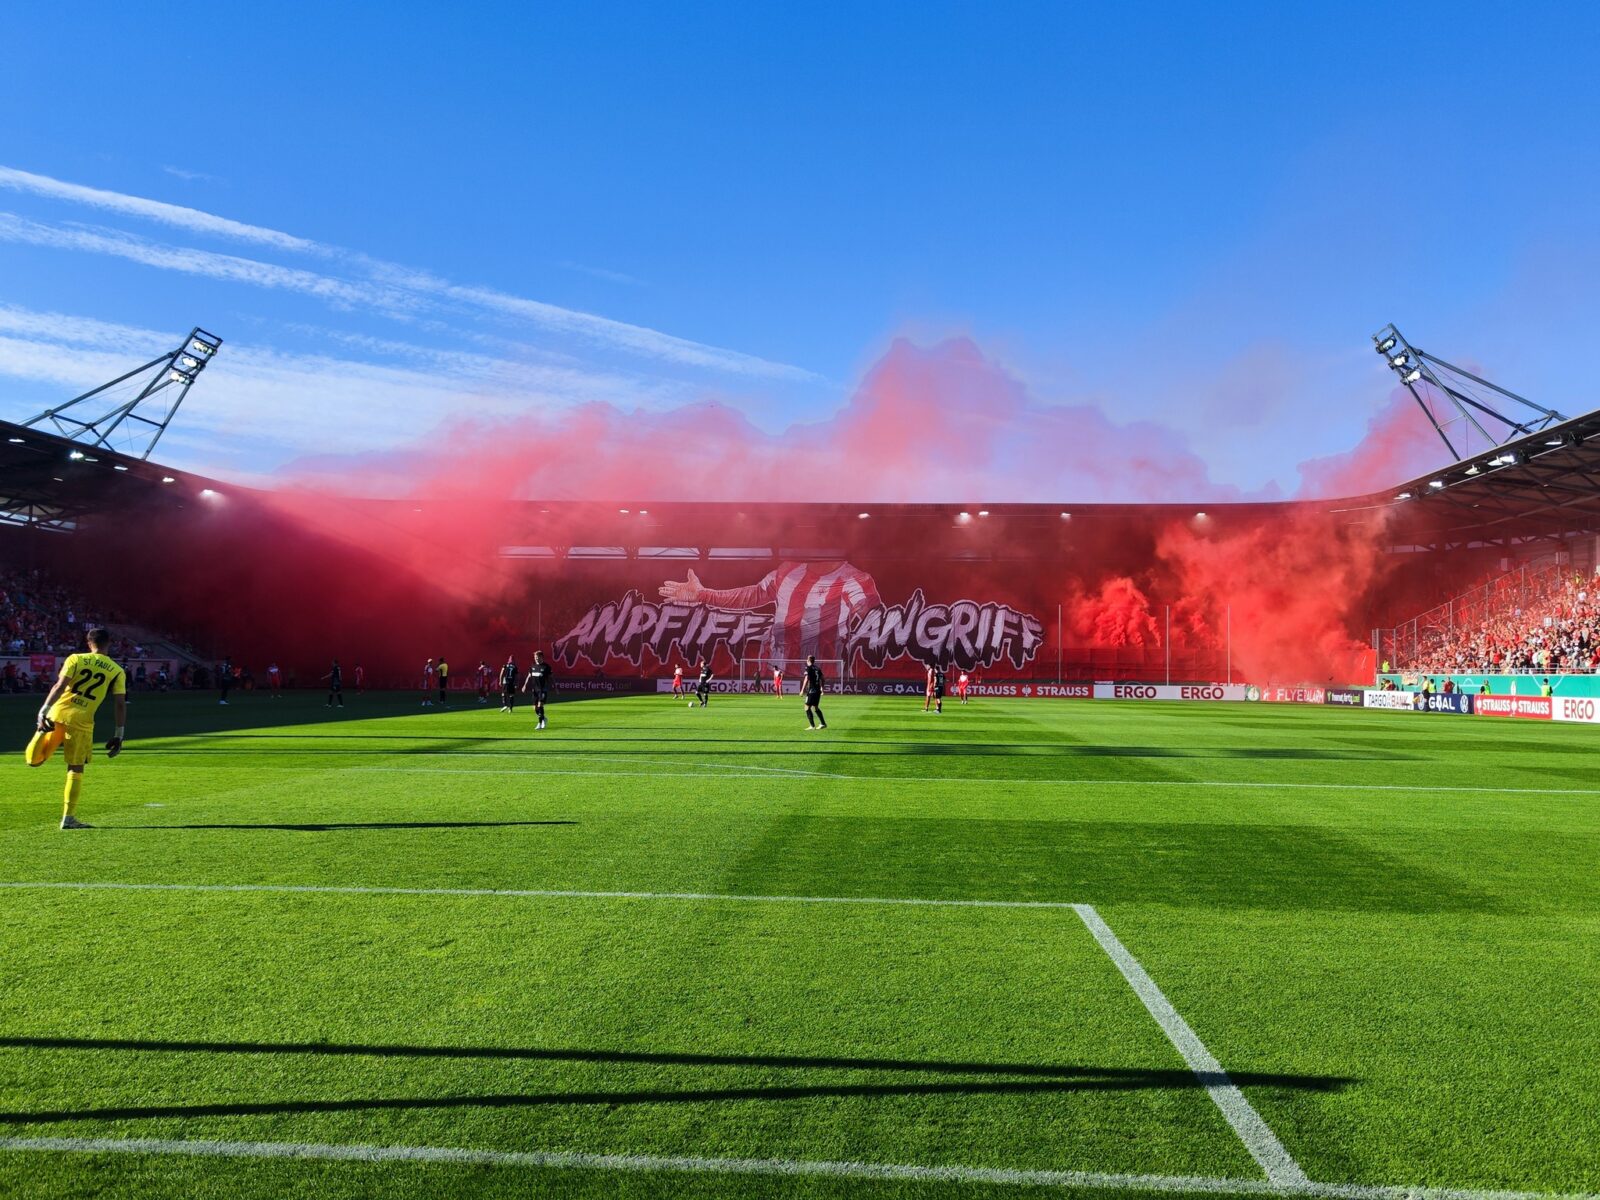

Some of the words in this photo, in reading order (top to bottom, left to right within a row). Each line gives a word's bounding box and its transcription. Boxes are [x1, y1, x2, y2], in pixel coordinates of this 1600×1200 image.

[554, 590, 776, 660] ANPFIFF
[847, 590, 1043, 665] ANGRIFF
[95, 660, 114, 672] PAULI
[71, 668, 106, 701] 22
[883, 683, 925, 694] GOAL
[966, 685, 1017, 695] STRAUSS
[1037, 686, 1089, 696] STRAUSS
[1114, 685, 1157, 699] ERGO
[1180, 686, 1224, 700] ERGO
[1482, 698, 1511, 713] STRAUSS
[1518, 700, 1549, 715] STRAUSS
[1563, 699, 1595, 720] ERGO
